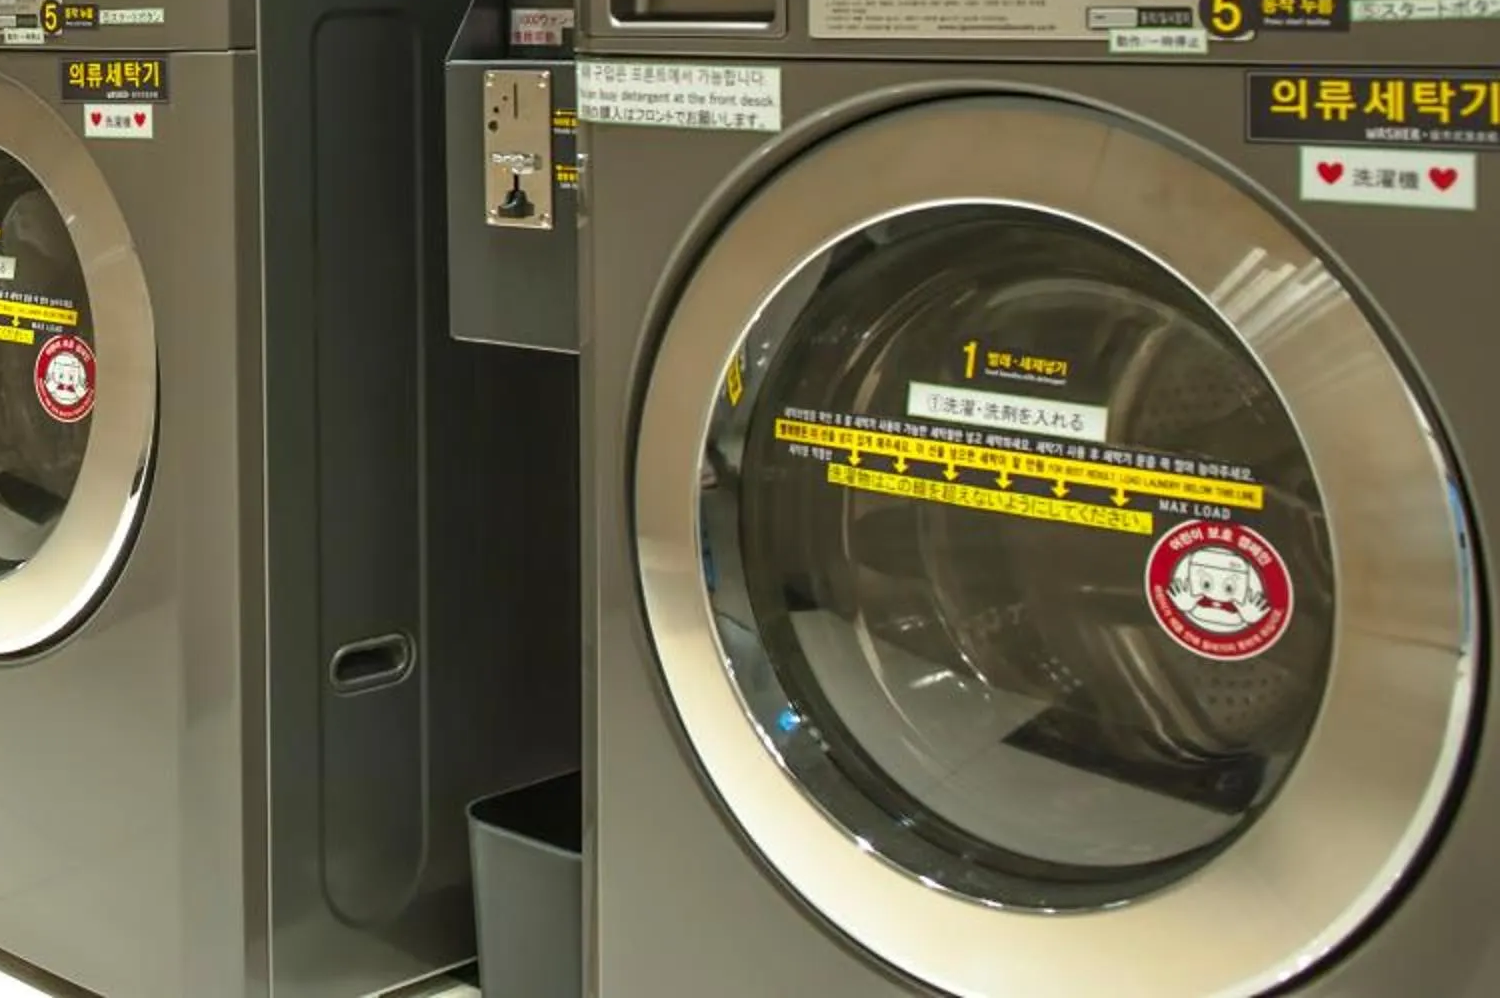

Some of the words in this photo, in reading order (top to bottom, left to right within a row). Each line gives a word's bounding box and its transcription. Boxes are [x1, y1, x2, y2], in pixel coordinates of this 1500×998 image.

[44, 4, 58, 31] 5
[69, 61, 160, 88] 의류세탁기
[1269, 77, 1500, 125] 의류세탁기
[1353, 167, 1420, 190] 洗濯機
[963, 340, 978, 379] 1
[1158, 500, 1189, 514] MAX
[1193, 505, 1232, 520] LOAD
